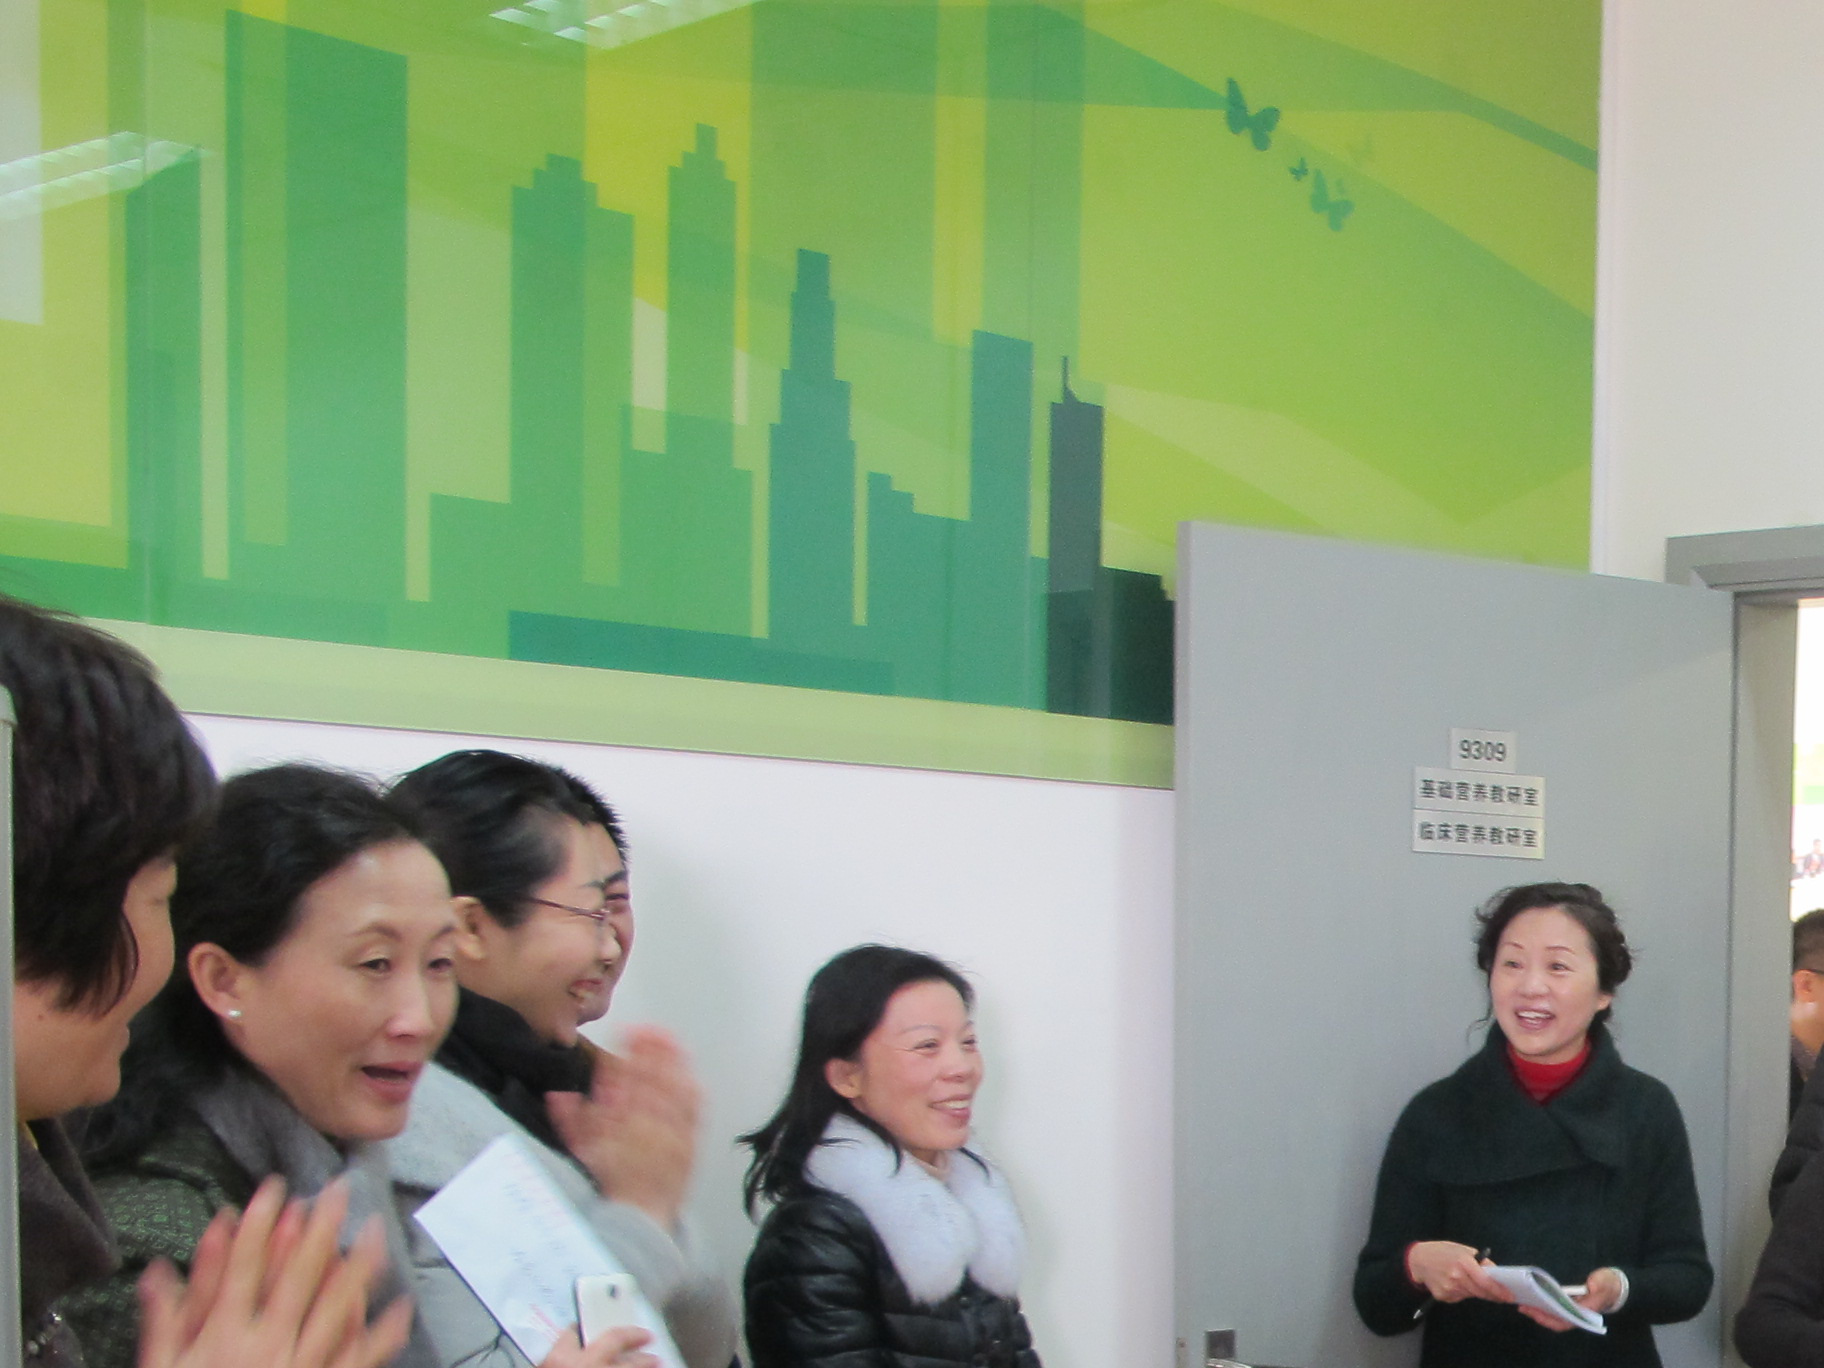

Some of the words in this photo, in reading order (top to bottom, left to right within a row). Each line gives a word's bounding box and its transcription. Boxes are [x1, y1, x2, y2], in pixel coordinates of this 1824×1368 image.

[1459, 739, 1506, 762] 9309
[1419, 779, 1538, 806] 基础营养教研室
[1418, 821, 1537, 848] 临床营养教研室
